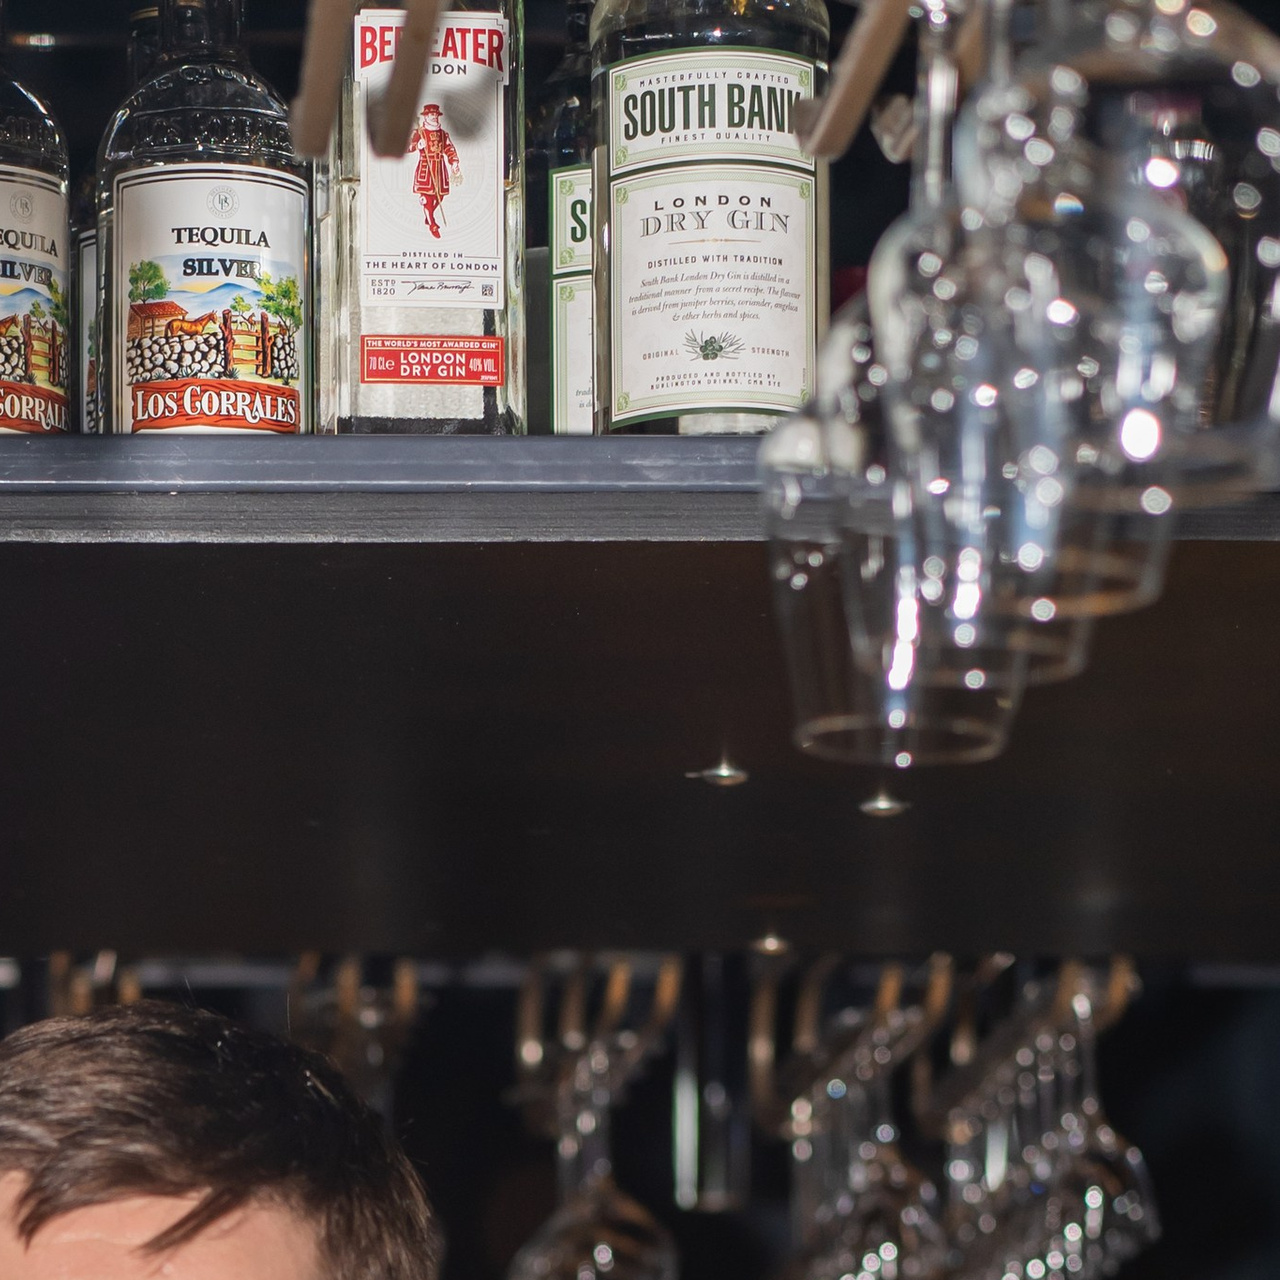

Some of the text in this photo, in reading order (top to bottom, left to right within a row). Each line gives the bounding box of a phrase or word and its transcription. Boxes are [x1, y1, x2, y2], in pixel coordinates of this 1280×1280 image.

[360, 26, 504, 73] BEATER
[431, 64, 467, 75] DON
[639, 71, 789, 87] MASTERFULLY CRAFTED
[624, 83, 716, 141] SOUTH
[661, 132, 771, 145] FINEST QUALITY
[654, 195, 771, 211] LONDON
[640, 209, 790, 238] DRY GIN
[172, 226, 270, 248] TEQUILA
[183, 257, 262, 279] SILVER
[366, 261, 498, 272] THE HEART OF LONDON
[647, 254, 783, 269] DISTILLED WITH TRADITION
[372, 287, 396, 296] 1820
[367, 340, 382, 348] THE
[419, 341, 440, 349] MOST
[442, 342, 482, 350] AWARDED
[400, 352, 466, 365] LONDON
[642, 346, 790, 361] ORIGINAL STRENGTH
[400, 365, 466, 378] DRY GIN
[655, 372, 698, 383] PRODUCED
[136, 385, 296, 424] LOS CORRALES
